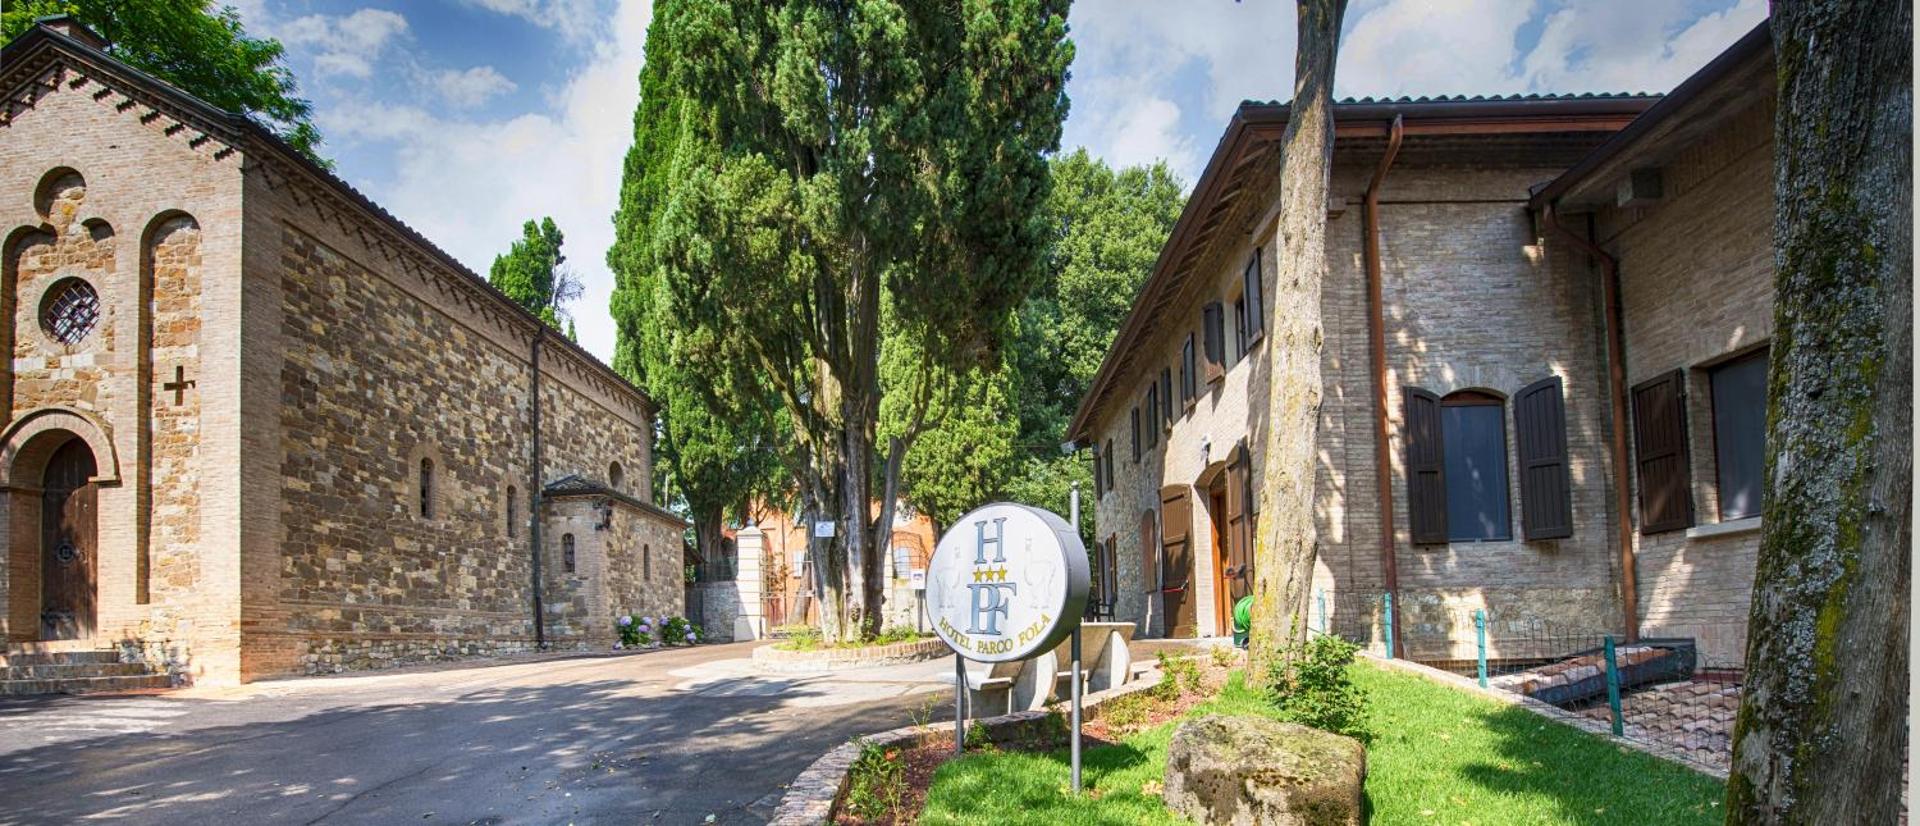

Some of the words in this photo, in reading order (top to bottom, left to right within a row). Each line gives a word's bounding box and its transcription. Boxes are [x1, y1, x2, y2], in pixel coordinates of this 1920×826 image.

[974, 517, 1007, 564] H
[938, 616, 972, 651] HOTEL
[976, 637, 1014, 655] PARCO
[1018, 612, 1051, 647] FOLA
